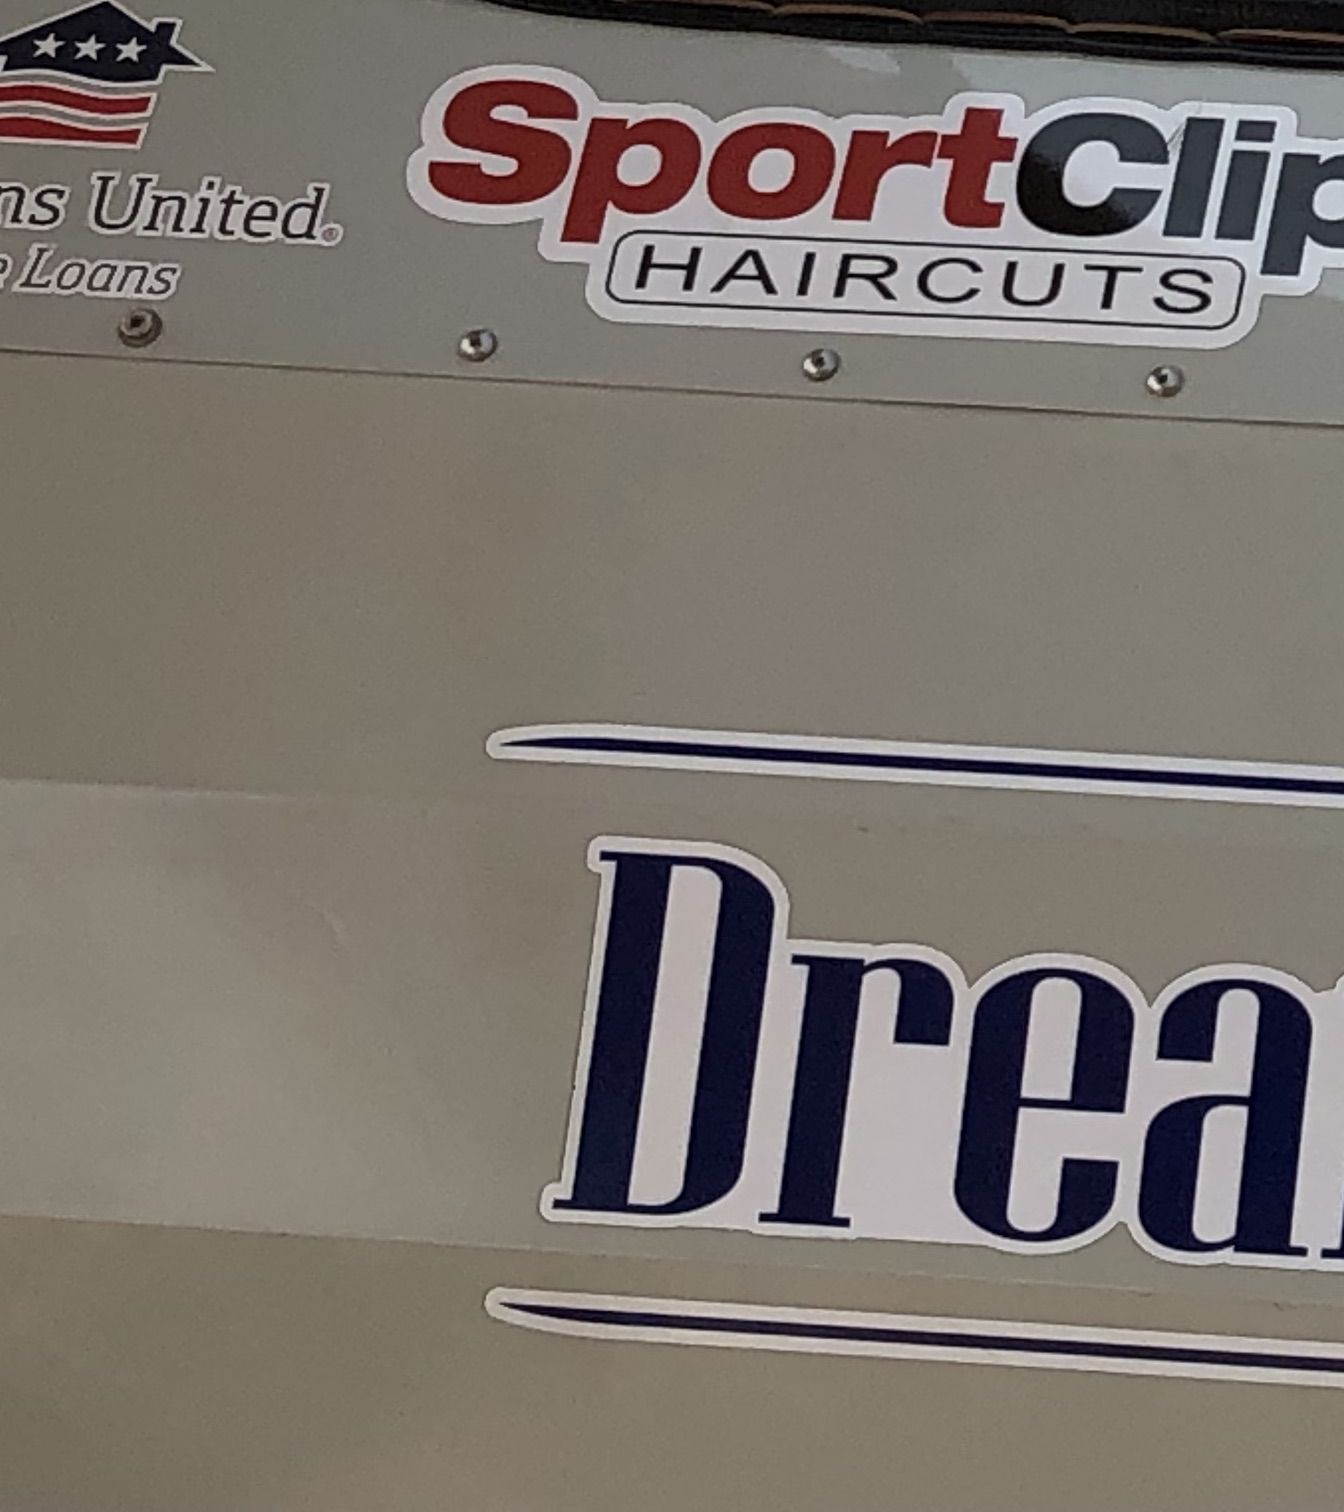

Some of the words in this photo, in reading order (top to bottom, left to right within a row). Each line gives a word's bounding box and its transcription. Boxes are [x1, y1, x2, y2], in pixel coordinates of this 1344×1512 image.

[93, 174, 327, 240] United
[19, 246, 178, 295] Loans
[634, 244, 1212, 314] HAIRCUTS
